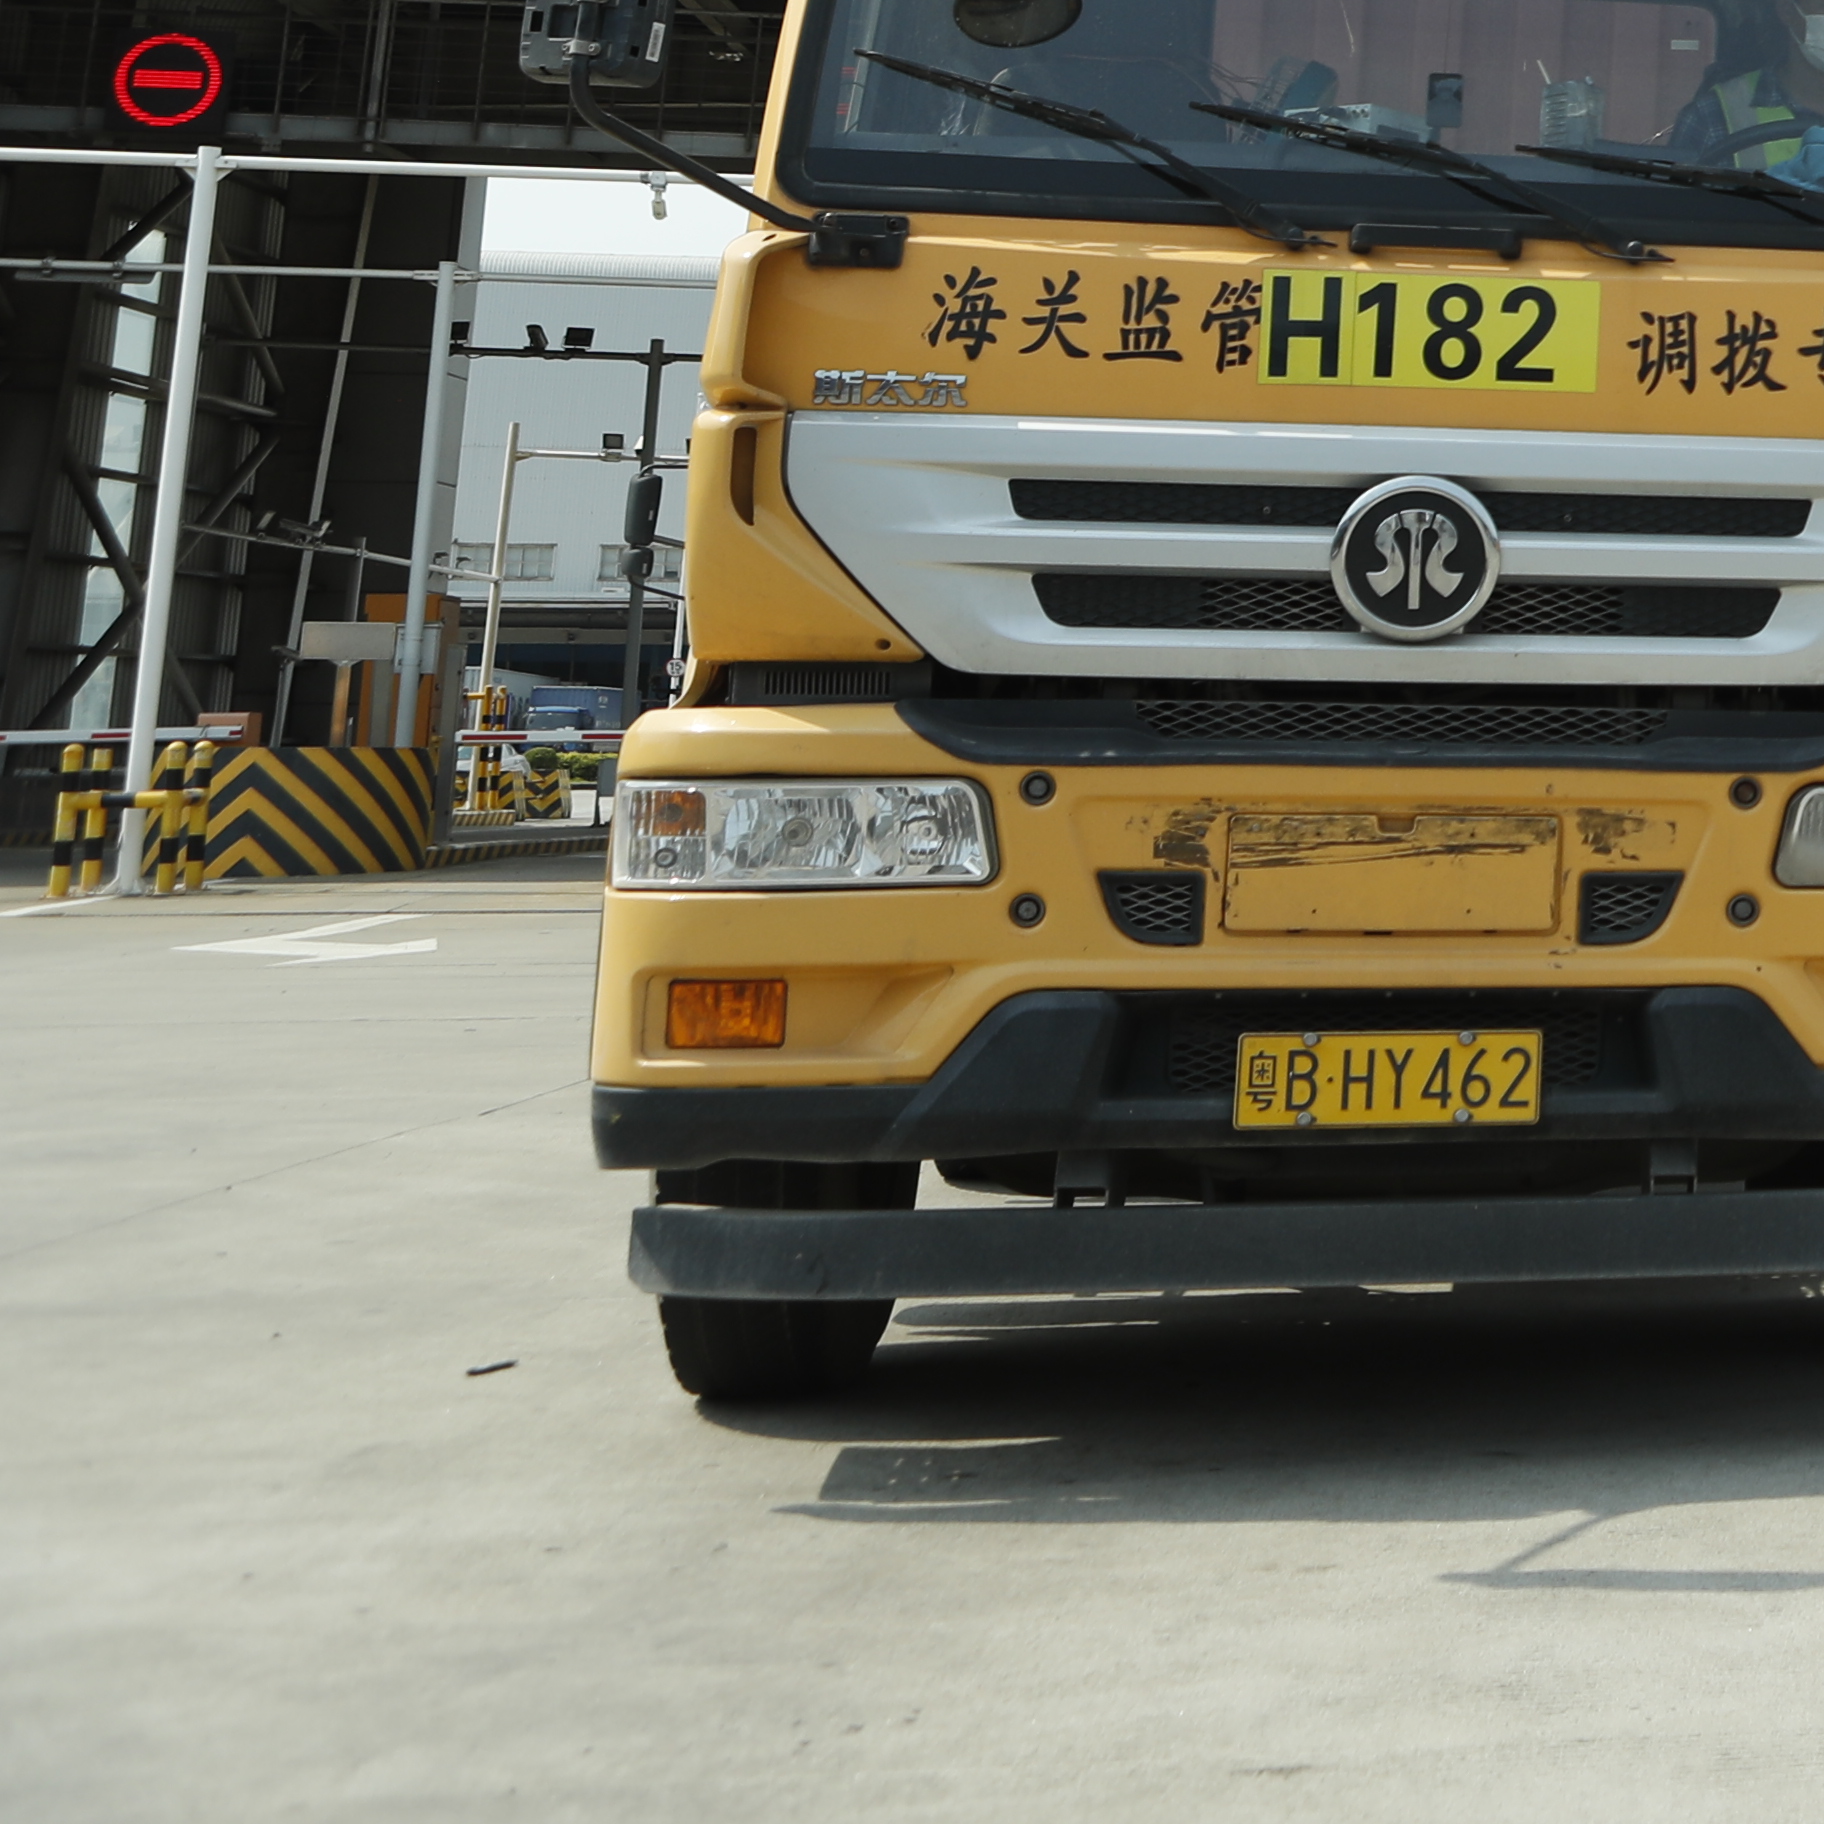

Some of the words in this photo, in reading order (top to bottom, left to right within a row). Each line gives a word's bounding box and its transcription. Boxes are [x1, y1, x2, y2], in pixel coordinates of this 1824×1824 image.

[921, 265, 1263, 374] 海关监管
[1267, 275, 1557, 383] H182
[813, 369, 968, 407] 斯太尔
[670, 662, 682, 671] 15
